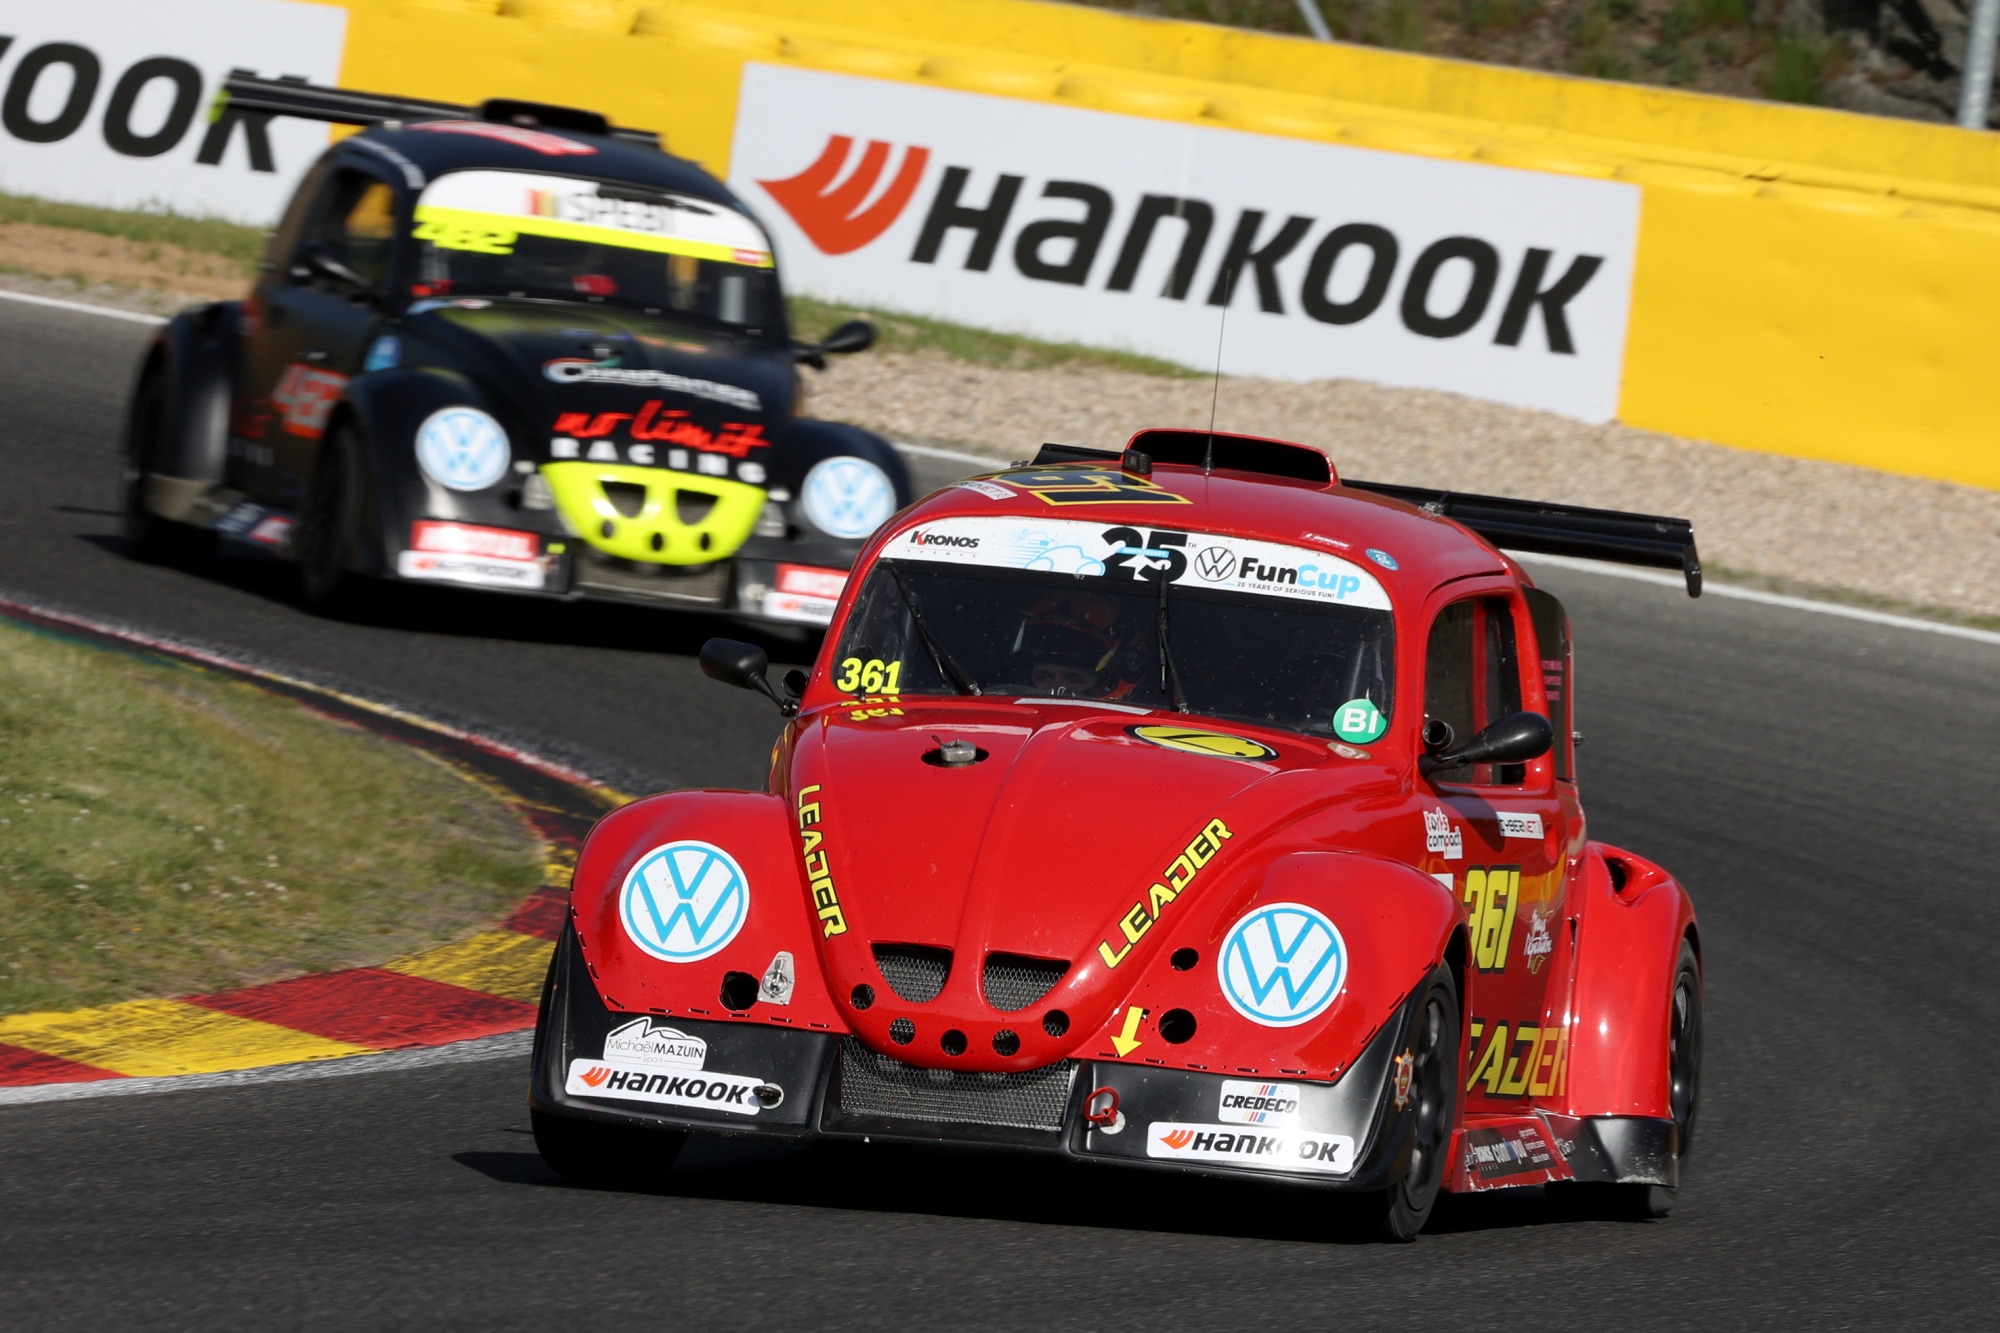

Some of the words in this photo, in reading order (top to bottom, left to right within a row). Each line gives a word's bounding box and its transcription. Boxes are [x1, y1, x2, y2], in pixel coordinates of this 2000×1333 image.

[550, 437, 767, 480] RACING
[909, 526, 980, 549] KRONOS
[1101, 527, 1188, 584] 25
[1248, 583, 1271, 591] YEARS
[1285, 587, 1316, 597] SERIOUS
[837, 657, 901, 695] 361
[1341, 707, 1380, 735] BI
[798, 783, 849, 941] LEADER
[1097, 817, 1235, 970] LEADER
[1463, 865, 1521, 975] 361
[1221, 1094, 1298, 1114] CREDECO
